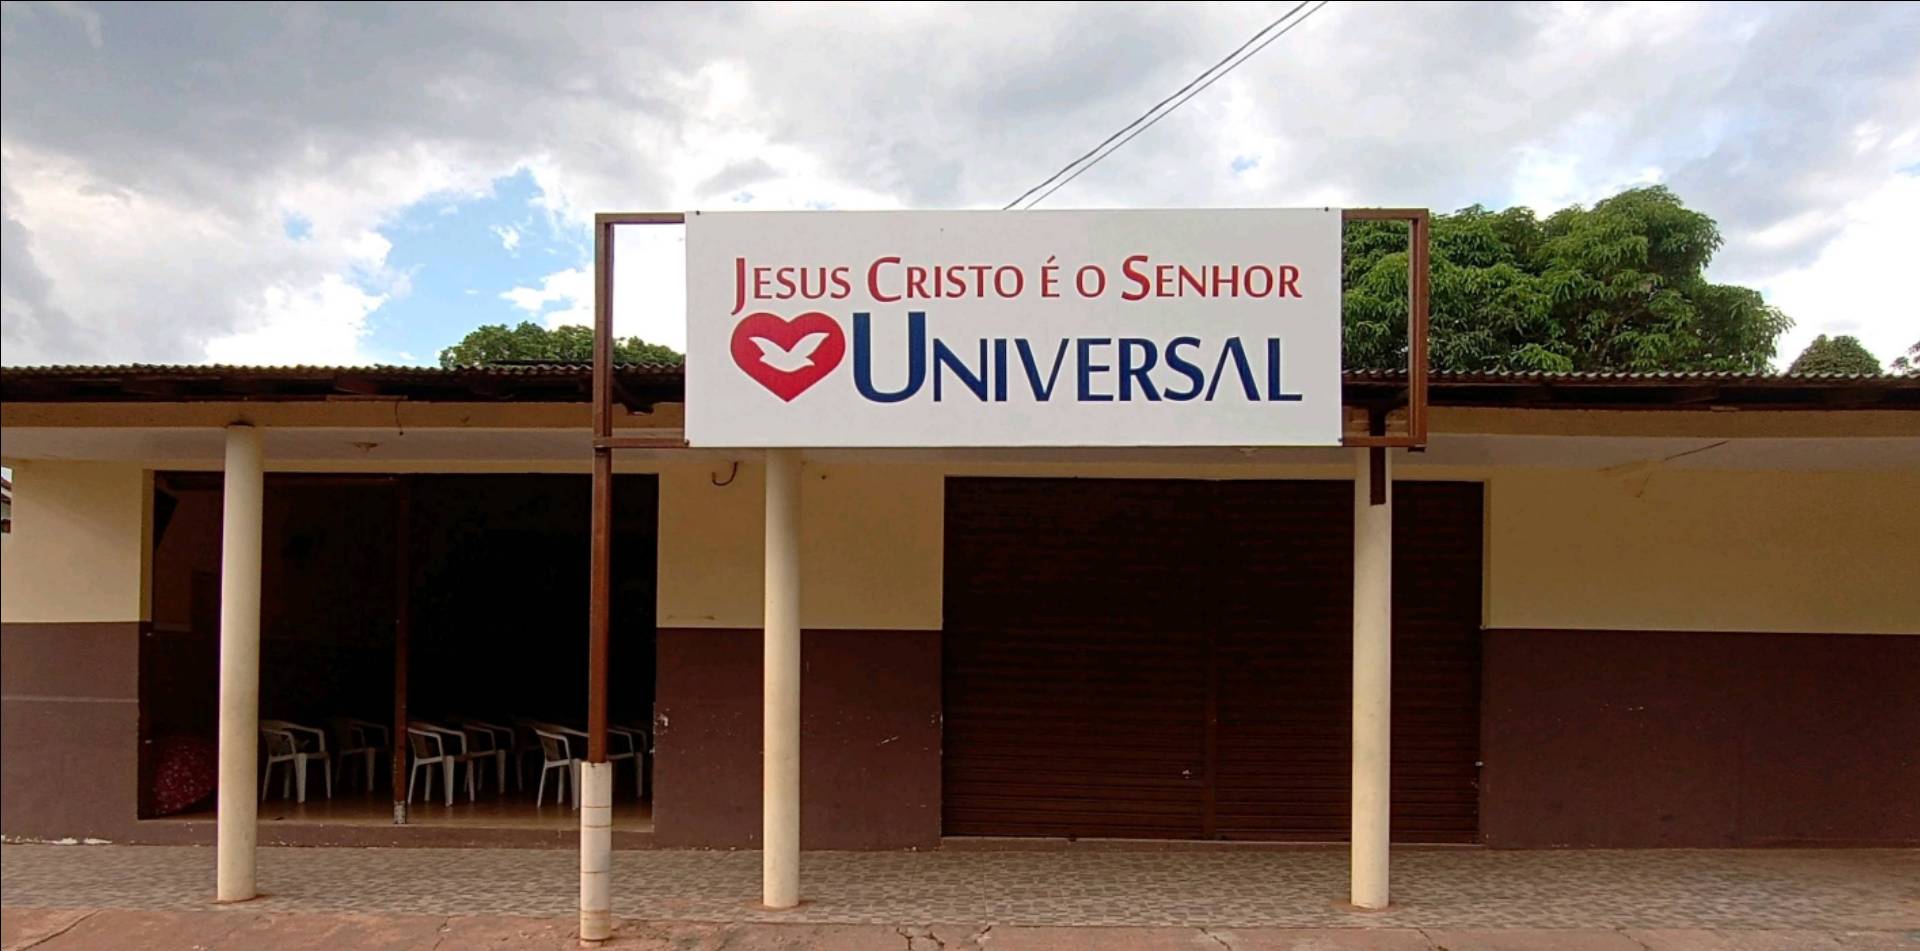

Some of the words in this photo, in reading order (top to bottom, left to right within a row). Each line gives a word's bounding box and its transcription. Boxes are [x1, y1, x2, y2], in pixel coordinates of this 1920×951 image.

[731, 257, 851, 316] JESUS
[867, 256, 1024, 303] CRISTO
[1040, 255, 1061, 298] É
[1075, 264, 1106, 299] O
[1120, 254, 1303, 302] SENHOR
[852, 311, 1303, 404] UNIVERSAL
